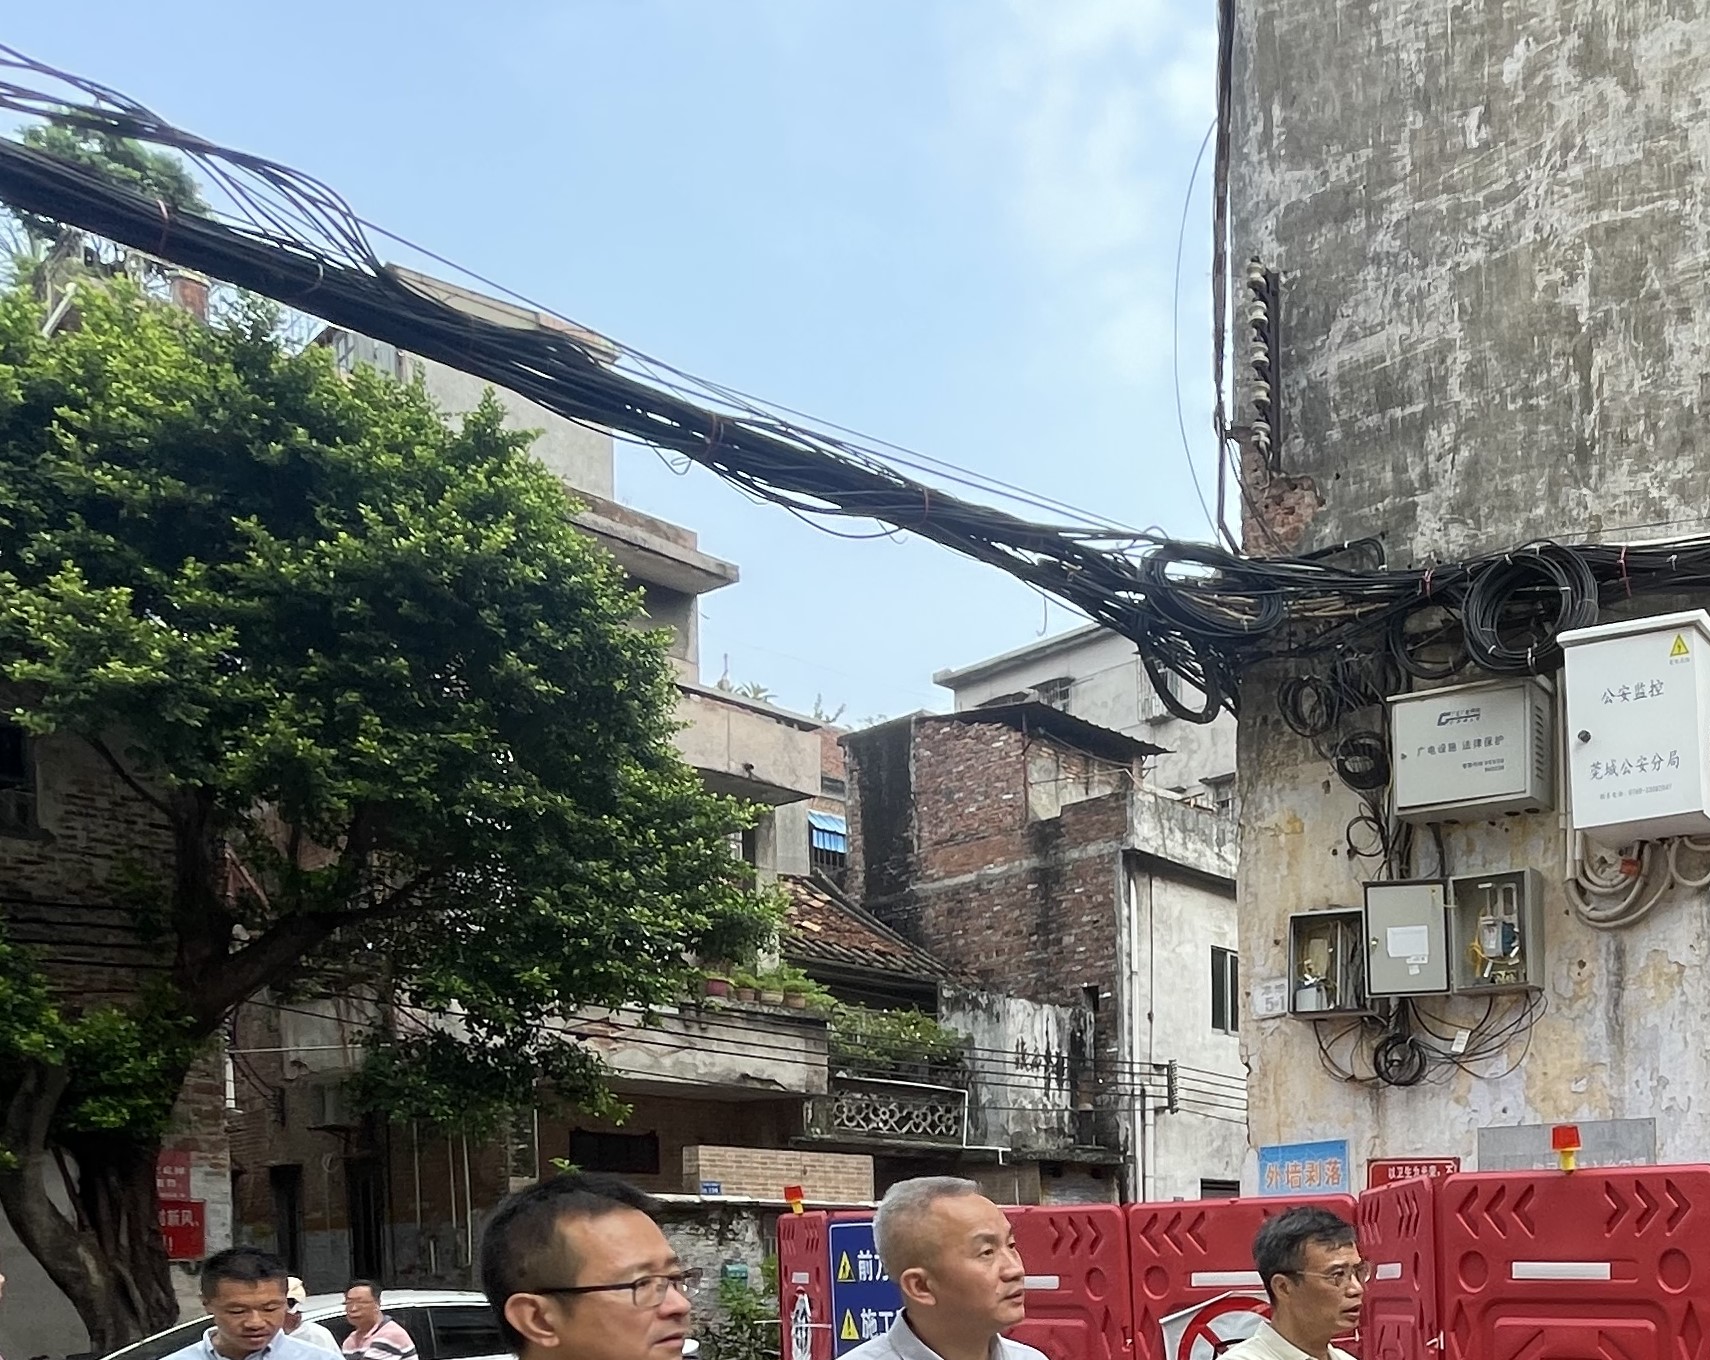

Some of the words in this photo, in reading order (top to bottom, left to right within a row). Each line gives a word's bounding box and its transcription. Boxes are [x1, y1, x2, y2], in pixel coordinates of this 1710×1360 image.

[1601, 679, 1665, 705] 公安监控
[1589, 750, 1681, 781] 莞城公安分局
[1265, 1157, 1342, 1190] 外墙剥落
